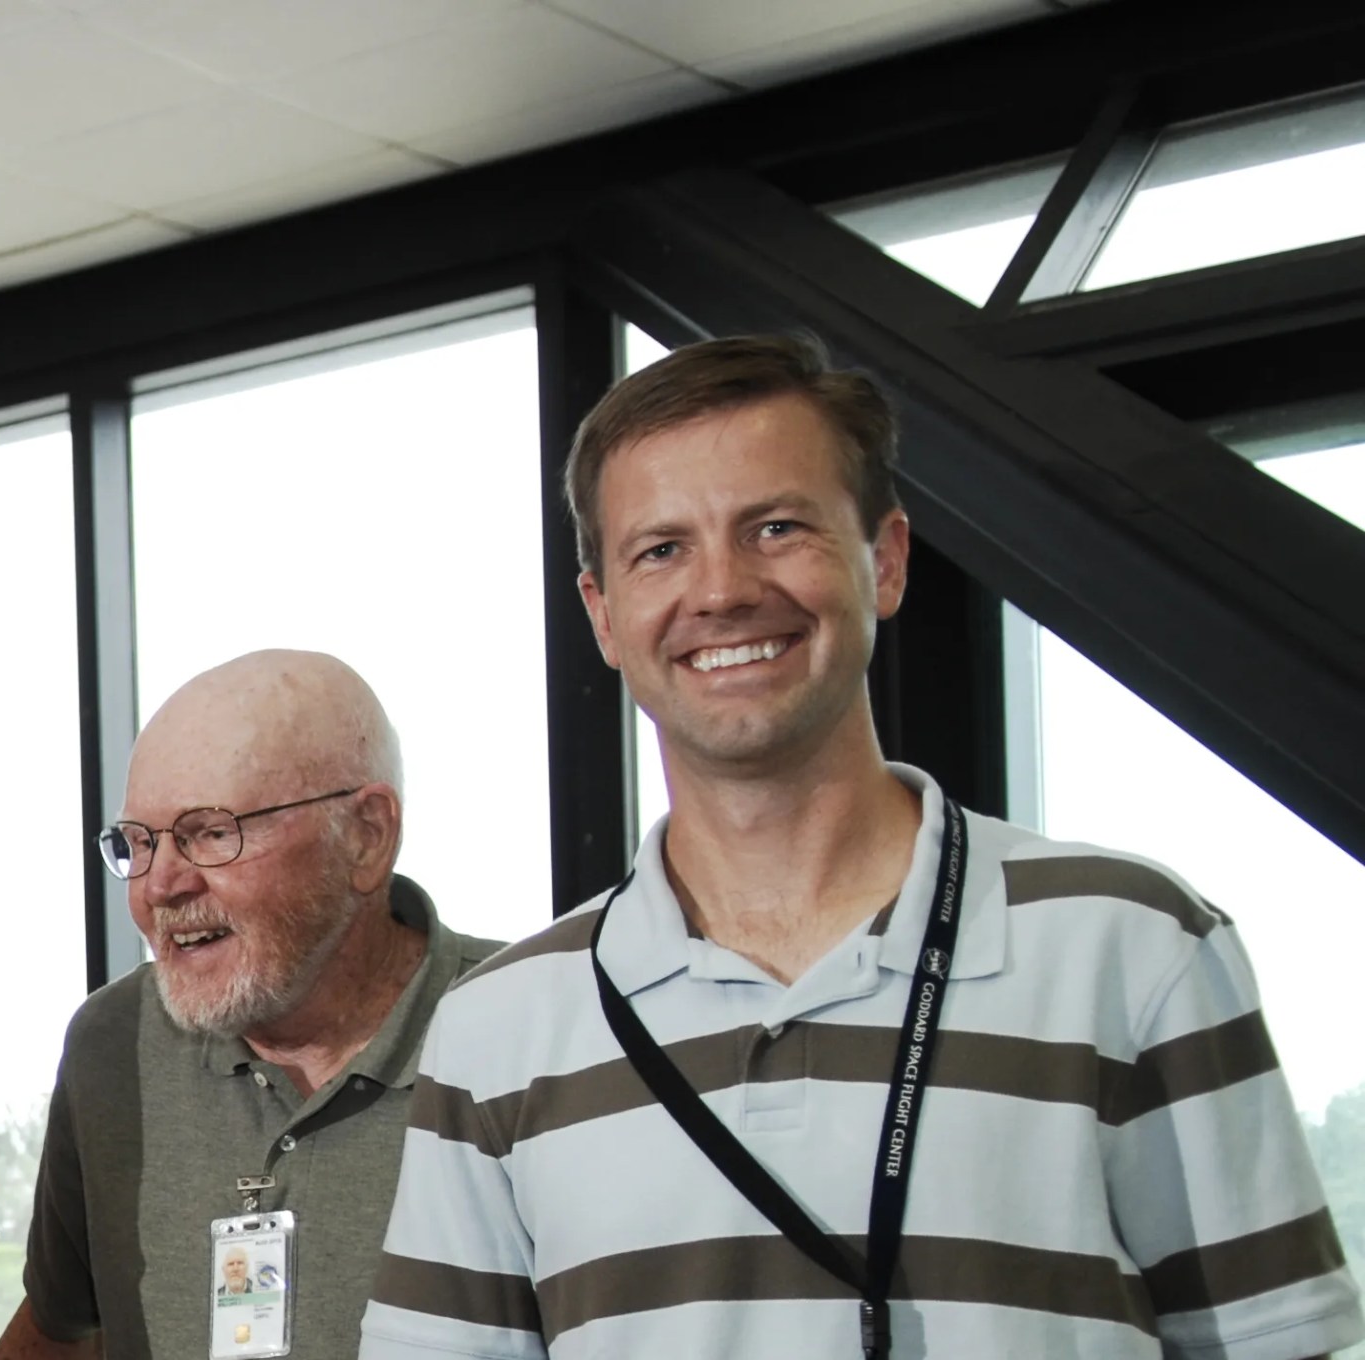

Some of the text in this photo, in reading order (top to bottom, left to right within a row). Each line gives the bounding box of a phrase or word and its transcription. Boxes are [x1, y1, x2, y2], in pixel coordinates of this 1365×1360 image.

[947, 847, 961, 881] FLIGHT
[940, 882, 956, 923] CENTER
[885, 982, 935, 1177] GODDARD SPACE FLIGHT CENTER
